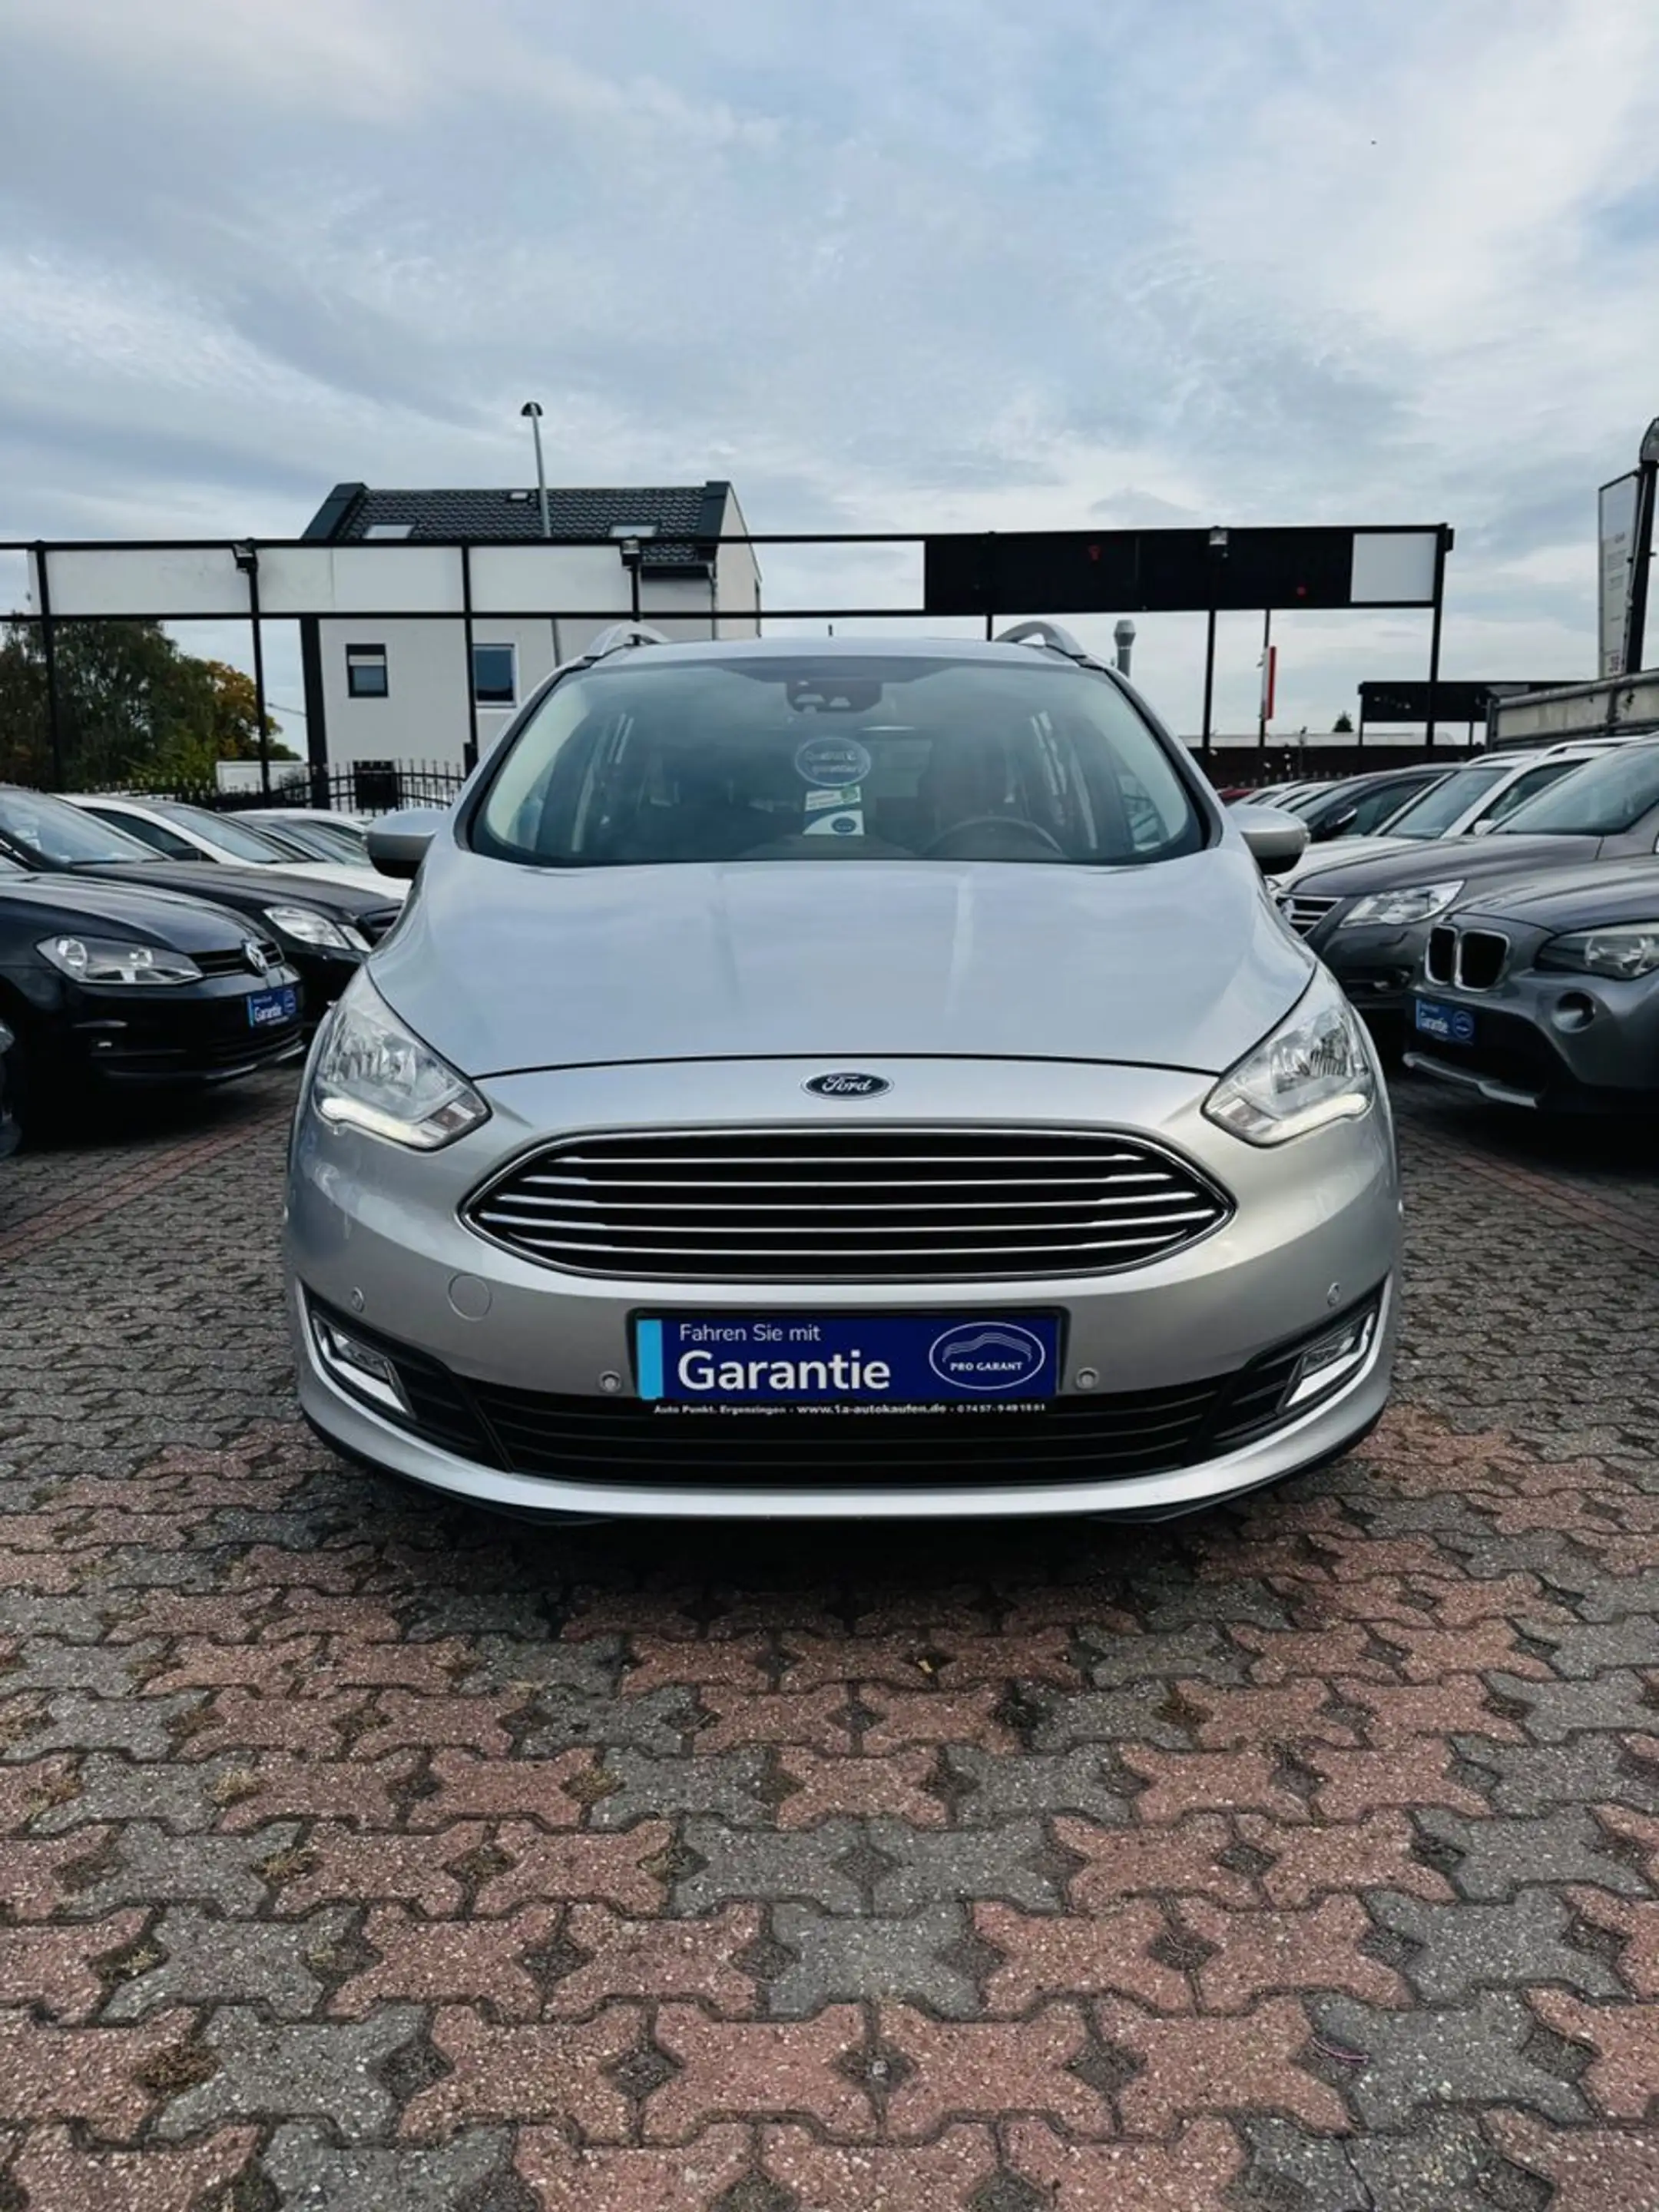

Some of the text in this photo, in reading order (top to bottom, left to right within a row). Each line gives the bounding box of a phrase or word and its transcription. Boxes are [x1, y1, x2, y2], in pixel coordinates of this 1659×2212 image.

[821, 1075, 873, 1092] Ford
[679, 1323, 822, 1342] Fahren Sie mit
[677, 1349, 892, 1391] Garantie
[949, 1361, 1023, 1372] PRO GARANT
[654, 1404, 680, 1414] Auto
